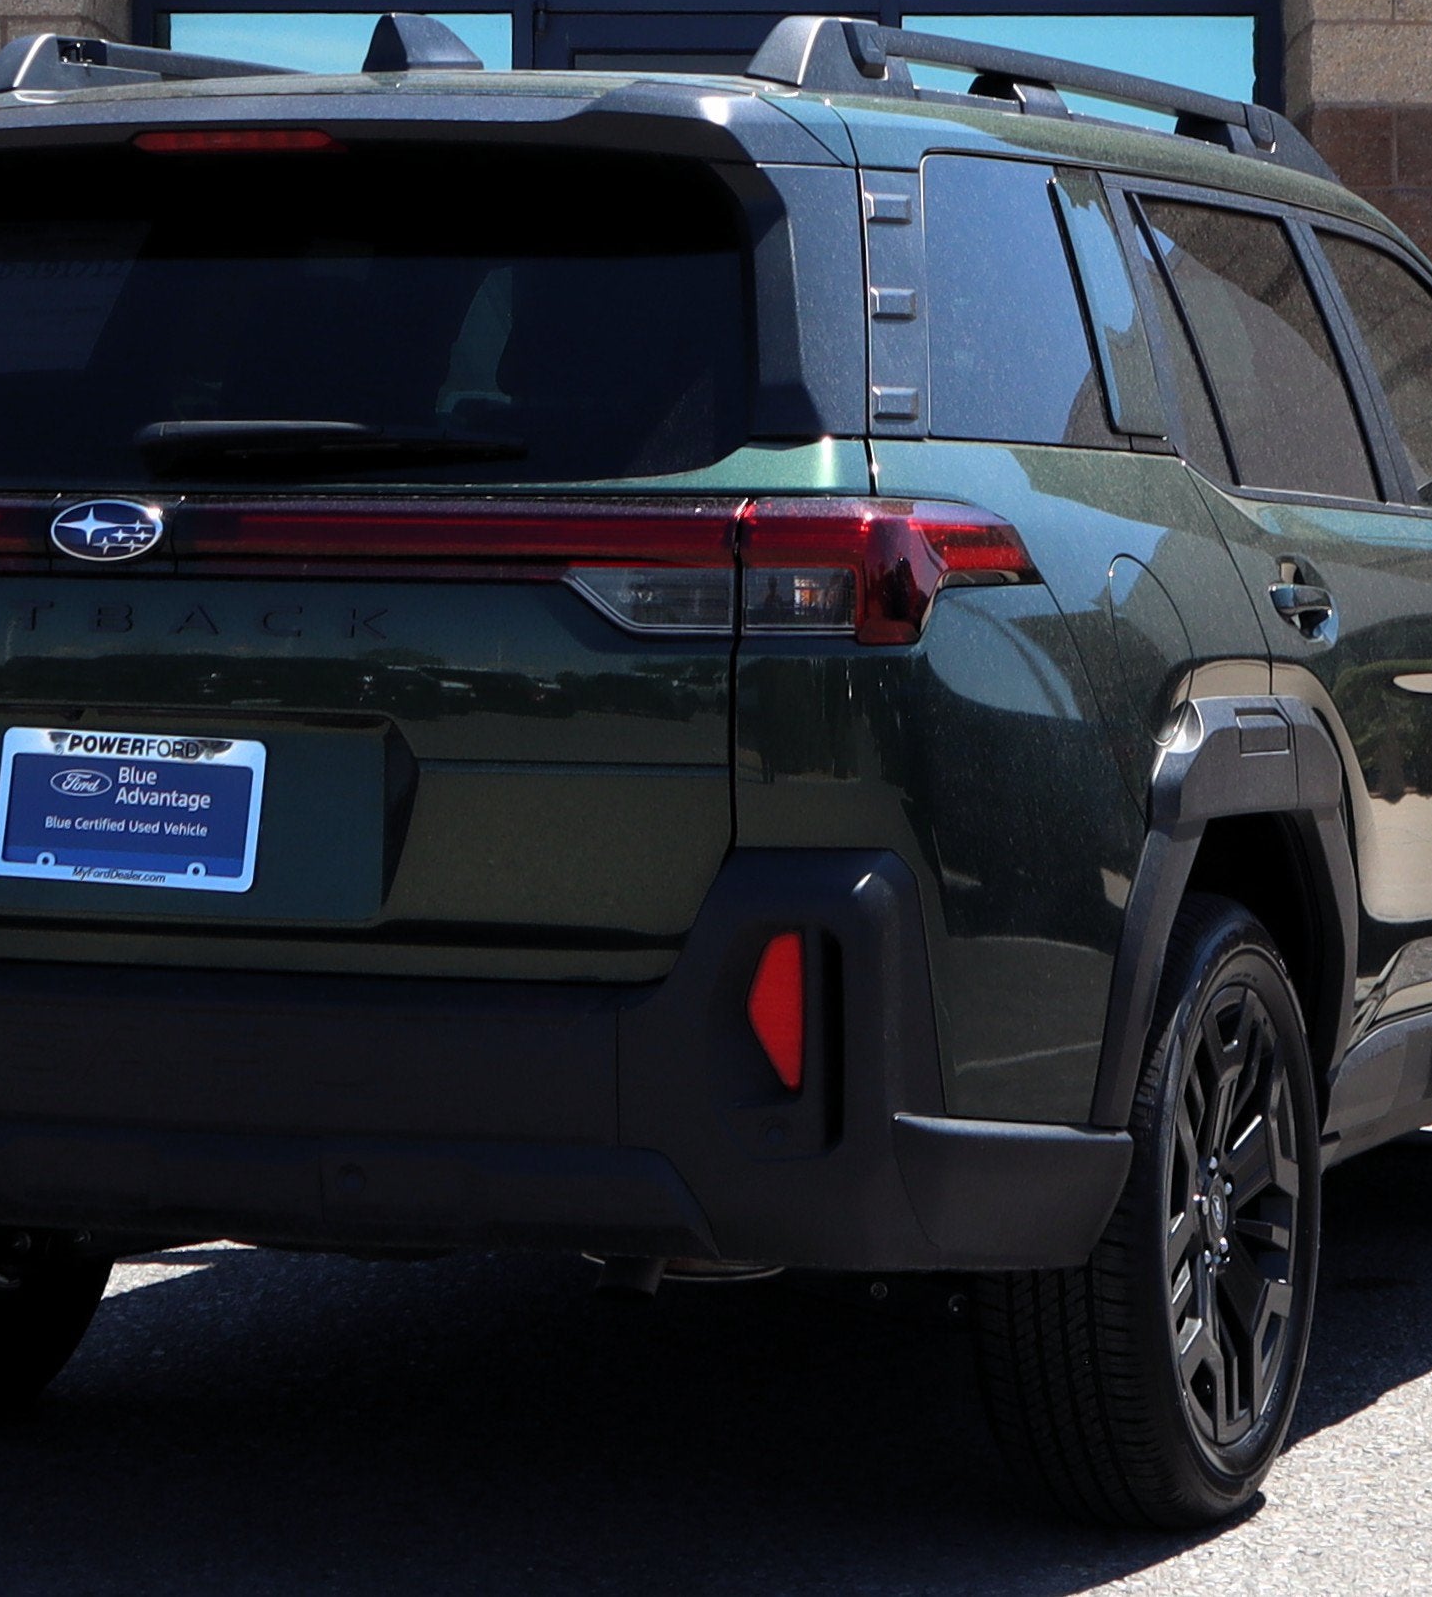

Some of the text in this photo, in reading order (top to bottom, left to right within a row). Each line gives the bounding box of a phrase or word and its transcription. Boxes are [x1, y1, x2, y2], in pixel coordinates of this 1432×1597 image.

[67, 734, 202, 760] POWERFORD
[62, 771, 101, 793] Ford
[118, 766, 157, 785] Blue
[115, 786, 211, 811] Advantage
[45, 815, 208, 837] Blue Certified Used Vehicle
[72, 866, 166, 884] MyFordDealer.com
